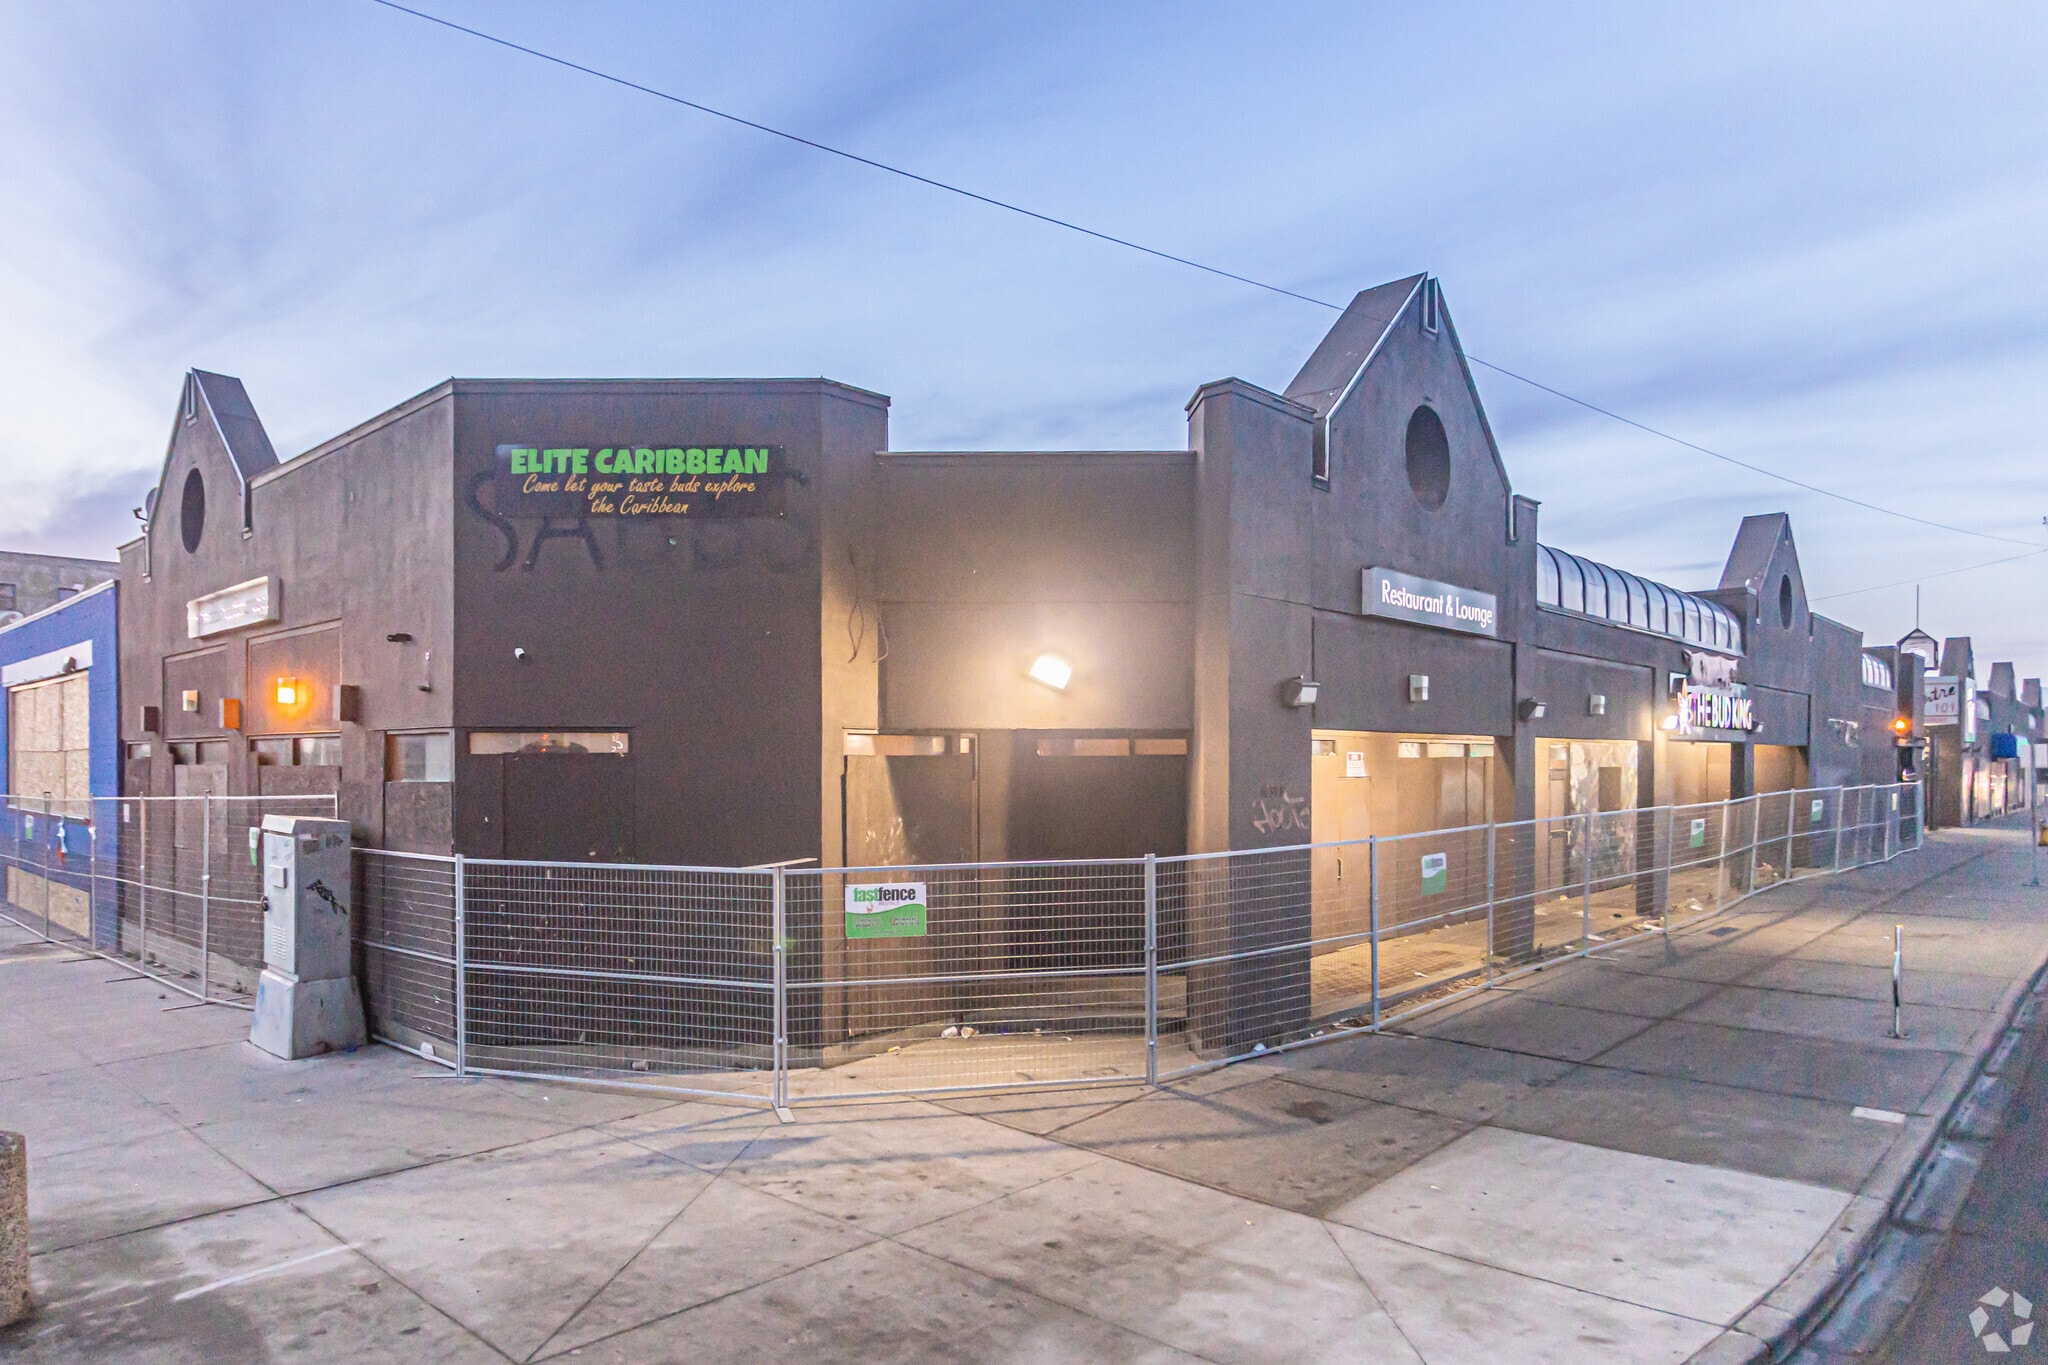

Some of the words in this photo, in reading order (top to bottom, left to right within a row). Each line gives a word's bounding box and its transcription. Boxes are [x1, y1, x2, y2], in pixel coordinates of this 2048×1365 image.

[511, 448, 589, 474] ELITE
[594, 448, 768, 474] CARIBBEAN
[523, 473, 558, 493] Come
[564, 474, 587, 492] let
[588, 481, 623, 500] your
[629, 478, 664, 492] taste
[669, 475, 700, 492] buds
[704, 474, 756, 500] explore
[591, 496, 615, 513] the
[620, 494, 689, 514] Caribbean
[1381, 579, 1443, 615] Restaurant
[1446, 594, 1454, 617] &
[1456, 597, 1493, 628] Lounge
[1691, 692, 1711, 727] THE
[1712, 694, 1732, 729] BUD
[1732, 697, 1752, 730] KING
[853, 886, 916, 902] fastfence
